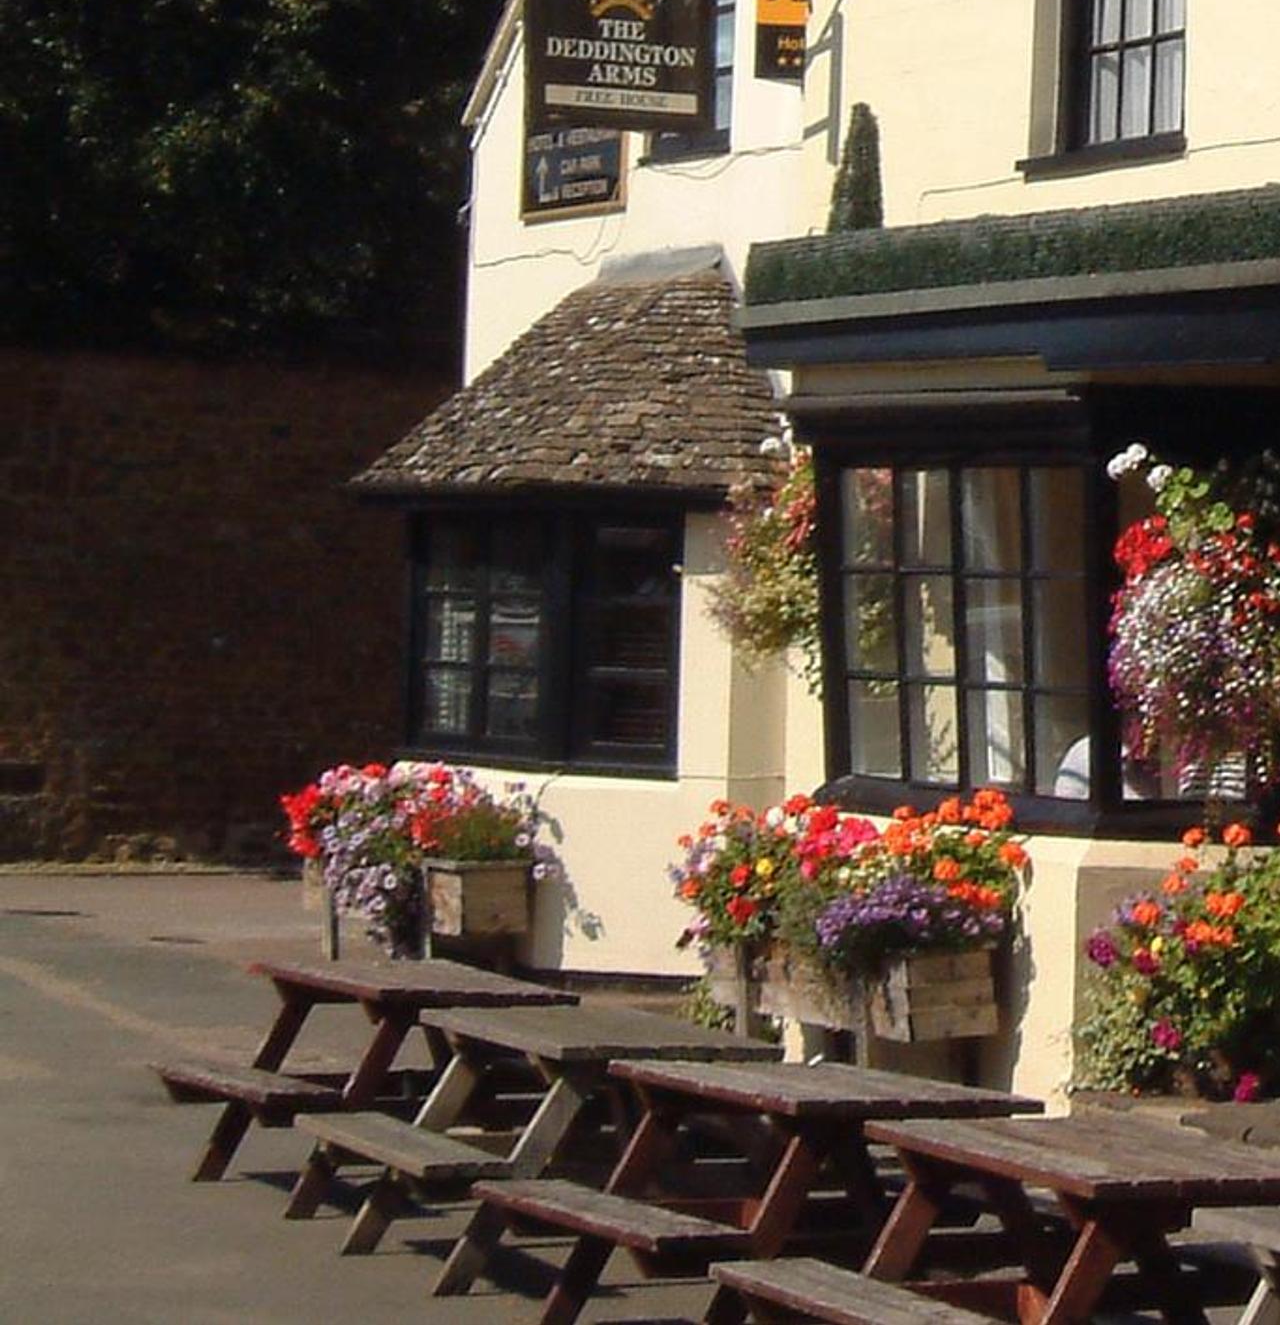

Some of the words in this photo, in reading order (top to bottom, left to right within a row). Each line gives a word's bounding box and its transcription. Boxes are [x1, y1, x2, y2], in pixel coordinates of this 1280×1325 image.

[598, 18, 646, 41] THE
[546, 37, 697, 67] DEDDINGTON
[587, 63, 657, 87] ARMS
[575, 89, 612, 103] FREE
[620, 92, 669, 108] HOUSE
